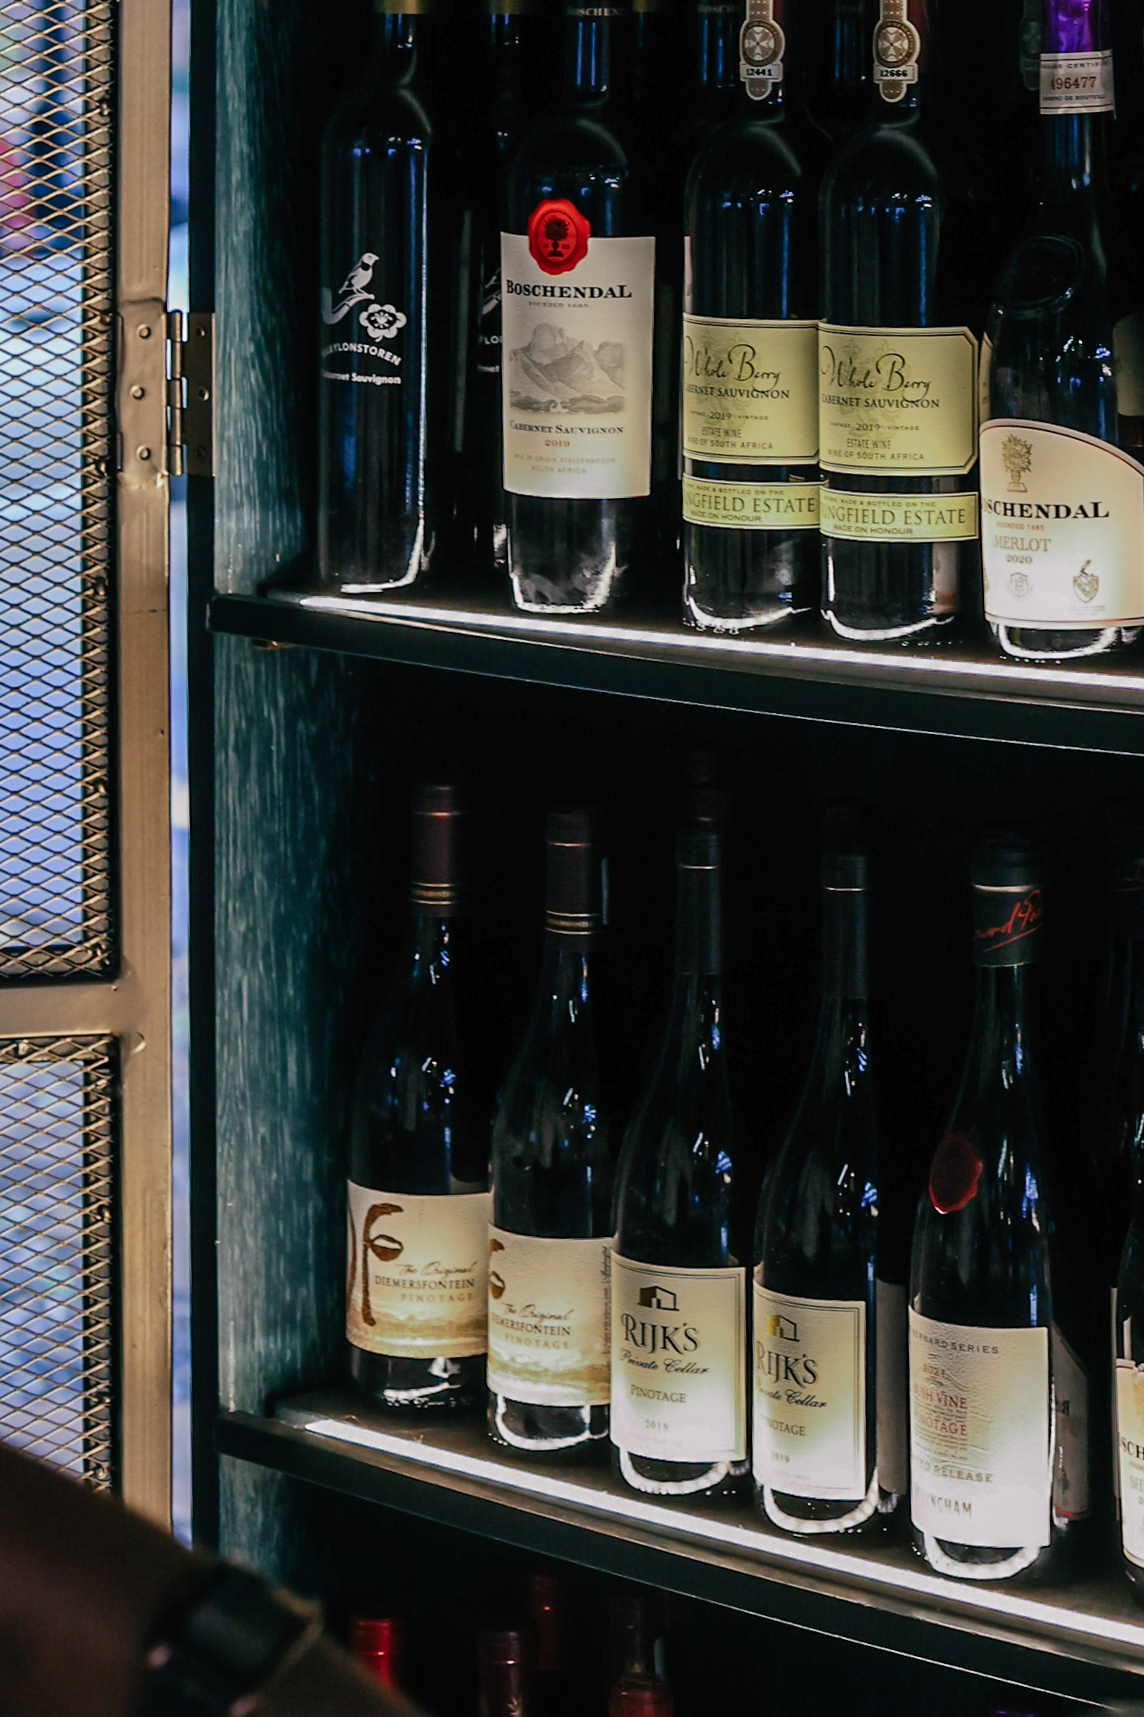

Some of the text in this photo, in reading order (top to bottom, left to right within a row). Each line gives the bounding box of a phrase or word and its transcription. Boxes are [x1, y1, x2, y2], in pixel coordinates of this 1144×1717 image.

[567, 7, 620, 17] SCHEN
[506, 279, 633, 299] BOSCHENDAL
[321, 342, 402, 366] BYLONSTOREN
[728, 343, 781, 394] Berry
[821, 345, 931, 404] Whole Berry
[351, 372, 402, 386] Sauvignon
[686, 383, 790, 399] BERNET SAUVIGNON
[864, 397, 940, 409] SAUVIGNON
[709, 411, 732, 421] 2019
[855, 422, 881, 432] 2019
[544, 439, 570, 448] 2019
[710, 440, 737, 448] SOUTH
[740, 442, 774, 450] AFRICA
[846, 438, 869, 449] ESTATE
[844, 449, 854, 458] OF
[856, 451, 886, 460] SOUTH
[890, 452, 925, 461] AFRICA
[718, 487, 751, 495] BOTTLED
[752, 497, 816, 514] ESTATE
[866, 500, 903, 508] BOTTLED
[721, 513, 762, 522] HONOUR
[821, 503, 966, 526] NGFIELD ESTATE
[870, 527, 914, 535] HONOUR
[993, 534, 1052, 553] MERLOT
[1006, 554, 1033, 564] 2020
[374, 1275, 476, 1290] DIEMERSFONTEIN
[400, 1293, 474, 1303] PINOTAGE
[504, 1333, 571, 1350] PINOTAGE
[951, 1341, 999, 1355] SERIES
[619, 1347, 710, 1375] Private Cellar
[630, 1383, 687, 1403] PINOTAGE
[785, 1388, 828, 1409] Cellar
[936, 1391, 968, 1410] VINE
[644, 1419, 669, 1430] 2019
[761, 1414, 806, 1437] NOTAGE
[914, 1408, 968, 1436] NOTAGE
[933, 1465, 994, 1483] RELEASE
